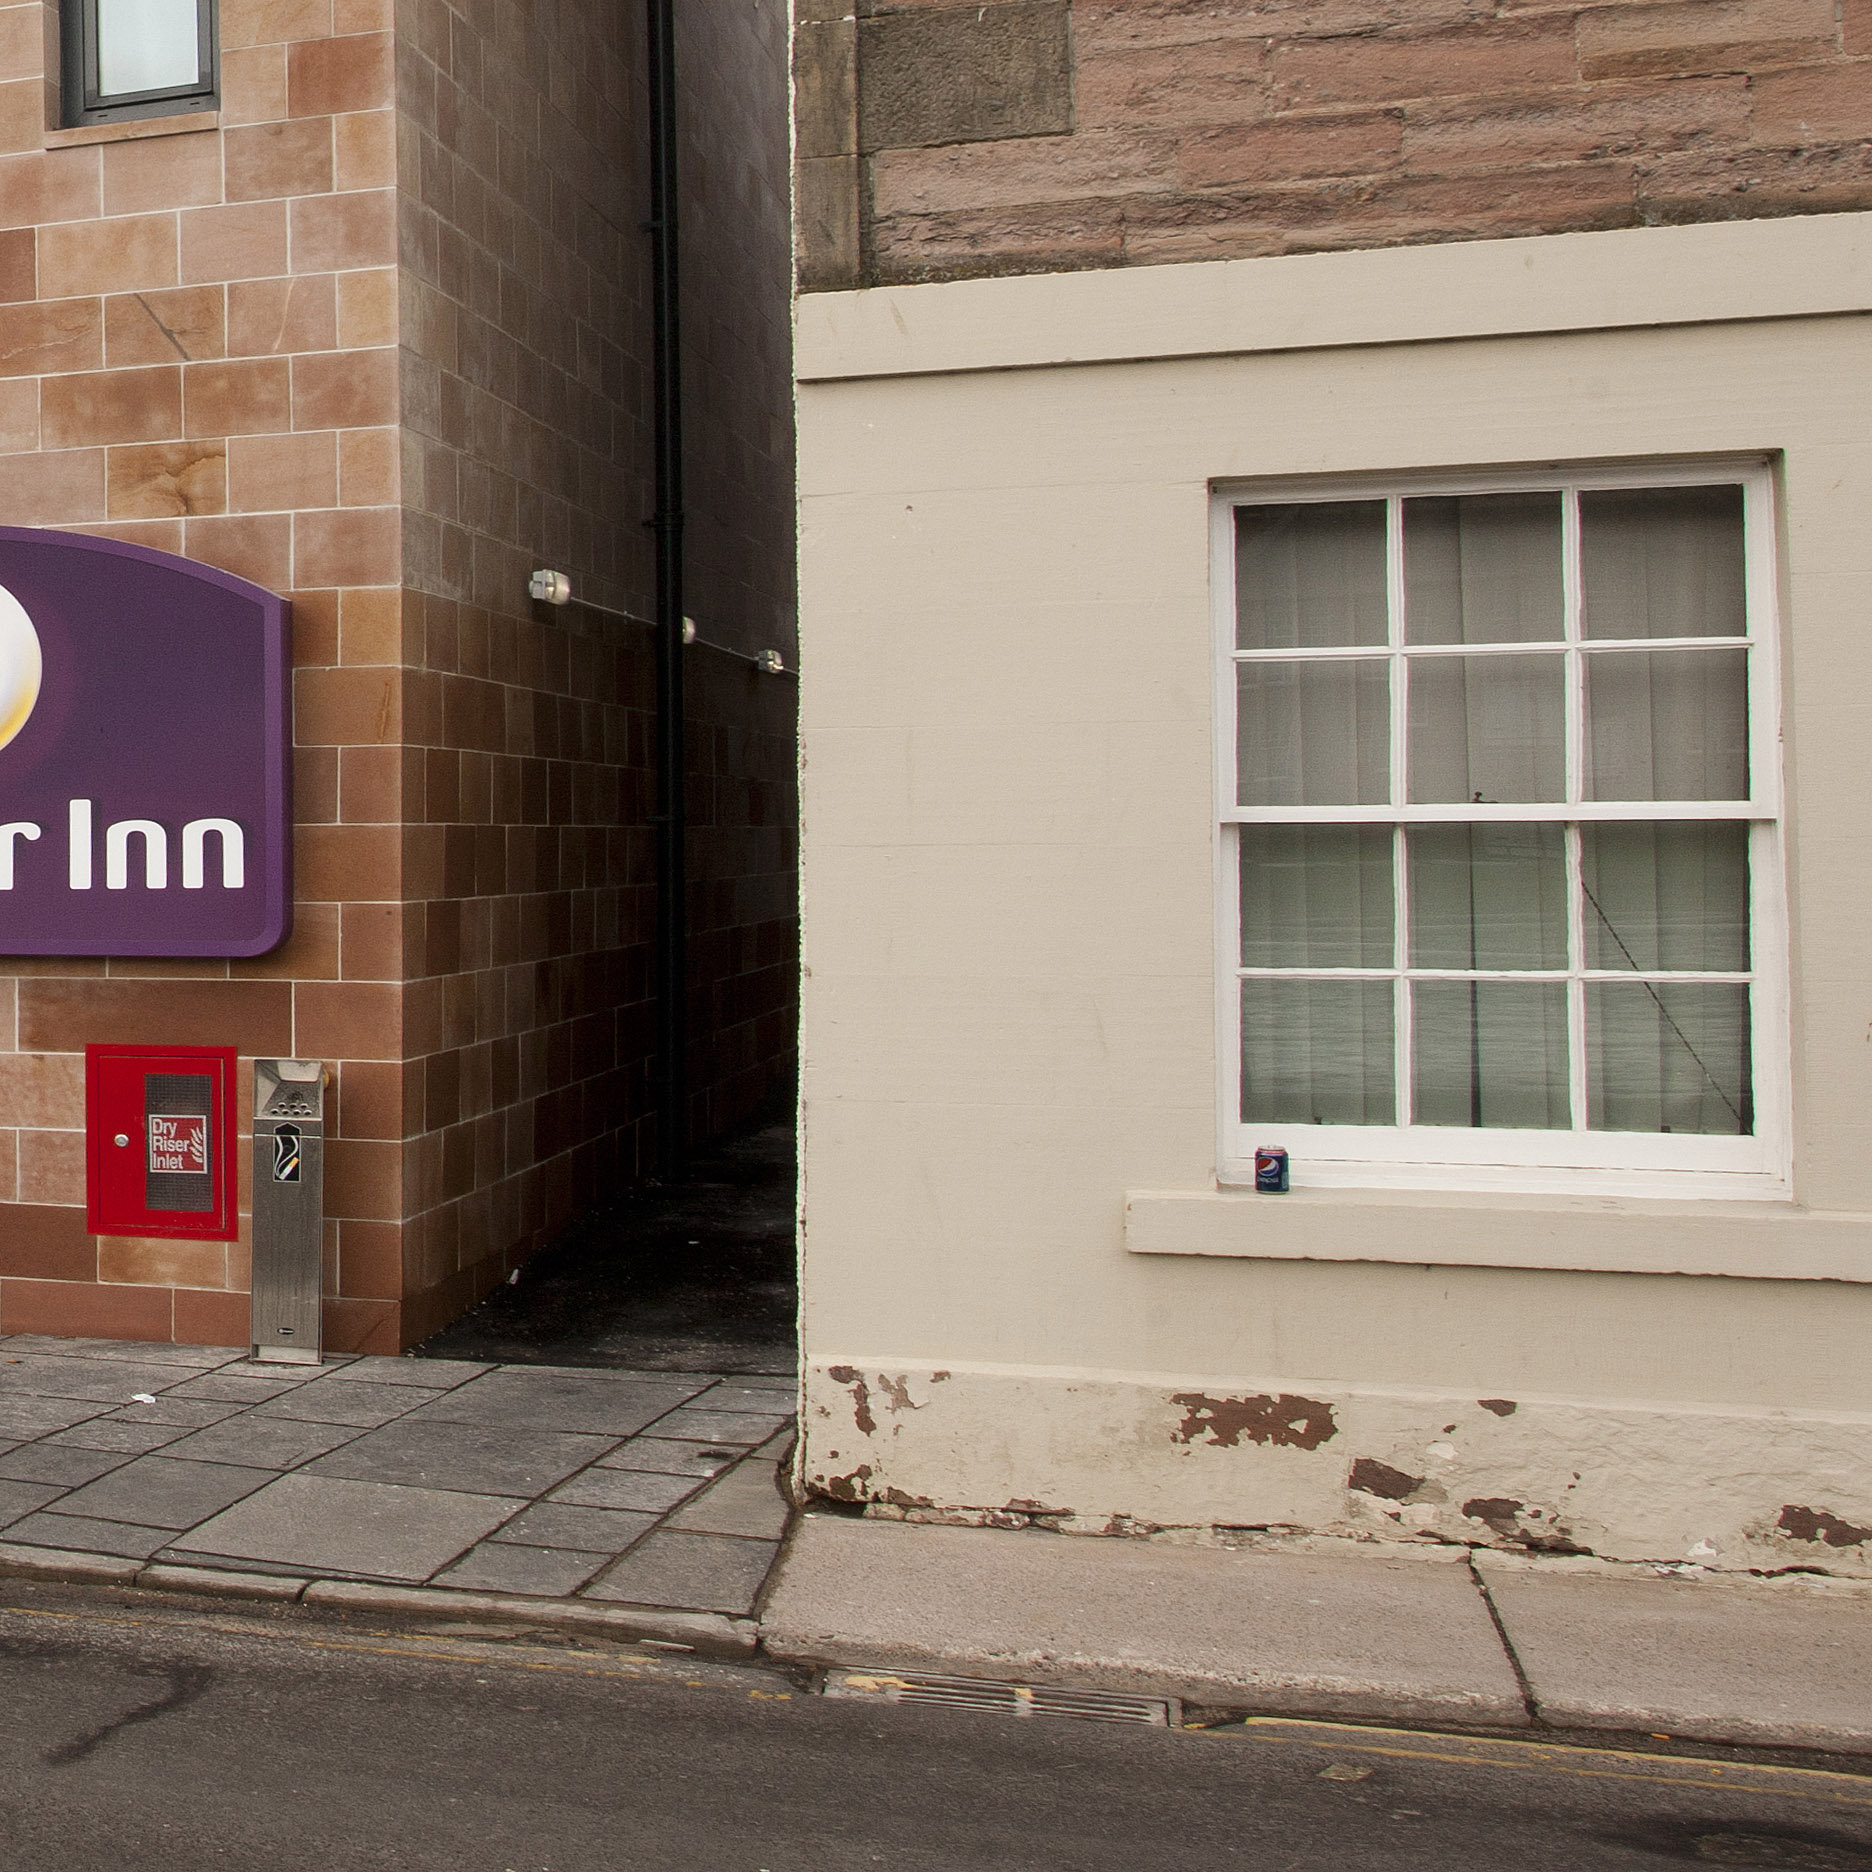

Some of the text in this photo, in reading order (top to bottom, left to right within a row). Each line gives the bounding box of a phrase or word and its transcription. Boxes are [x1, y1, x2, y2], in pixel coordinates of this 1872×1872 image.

[68, 798, 245, 890] Inn
[152, 1118, 177, 1139] Dry
[153, 1135, 190, 1152] Riser
[153, 1152, 184, 1169] Inlet
